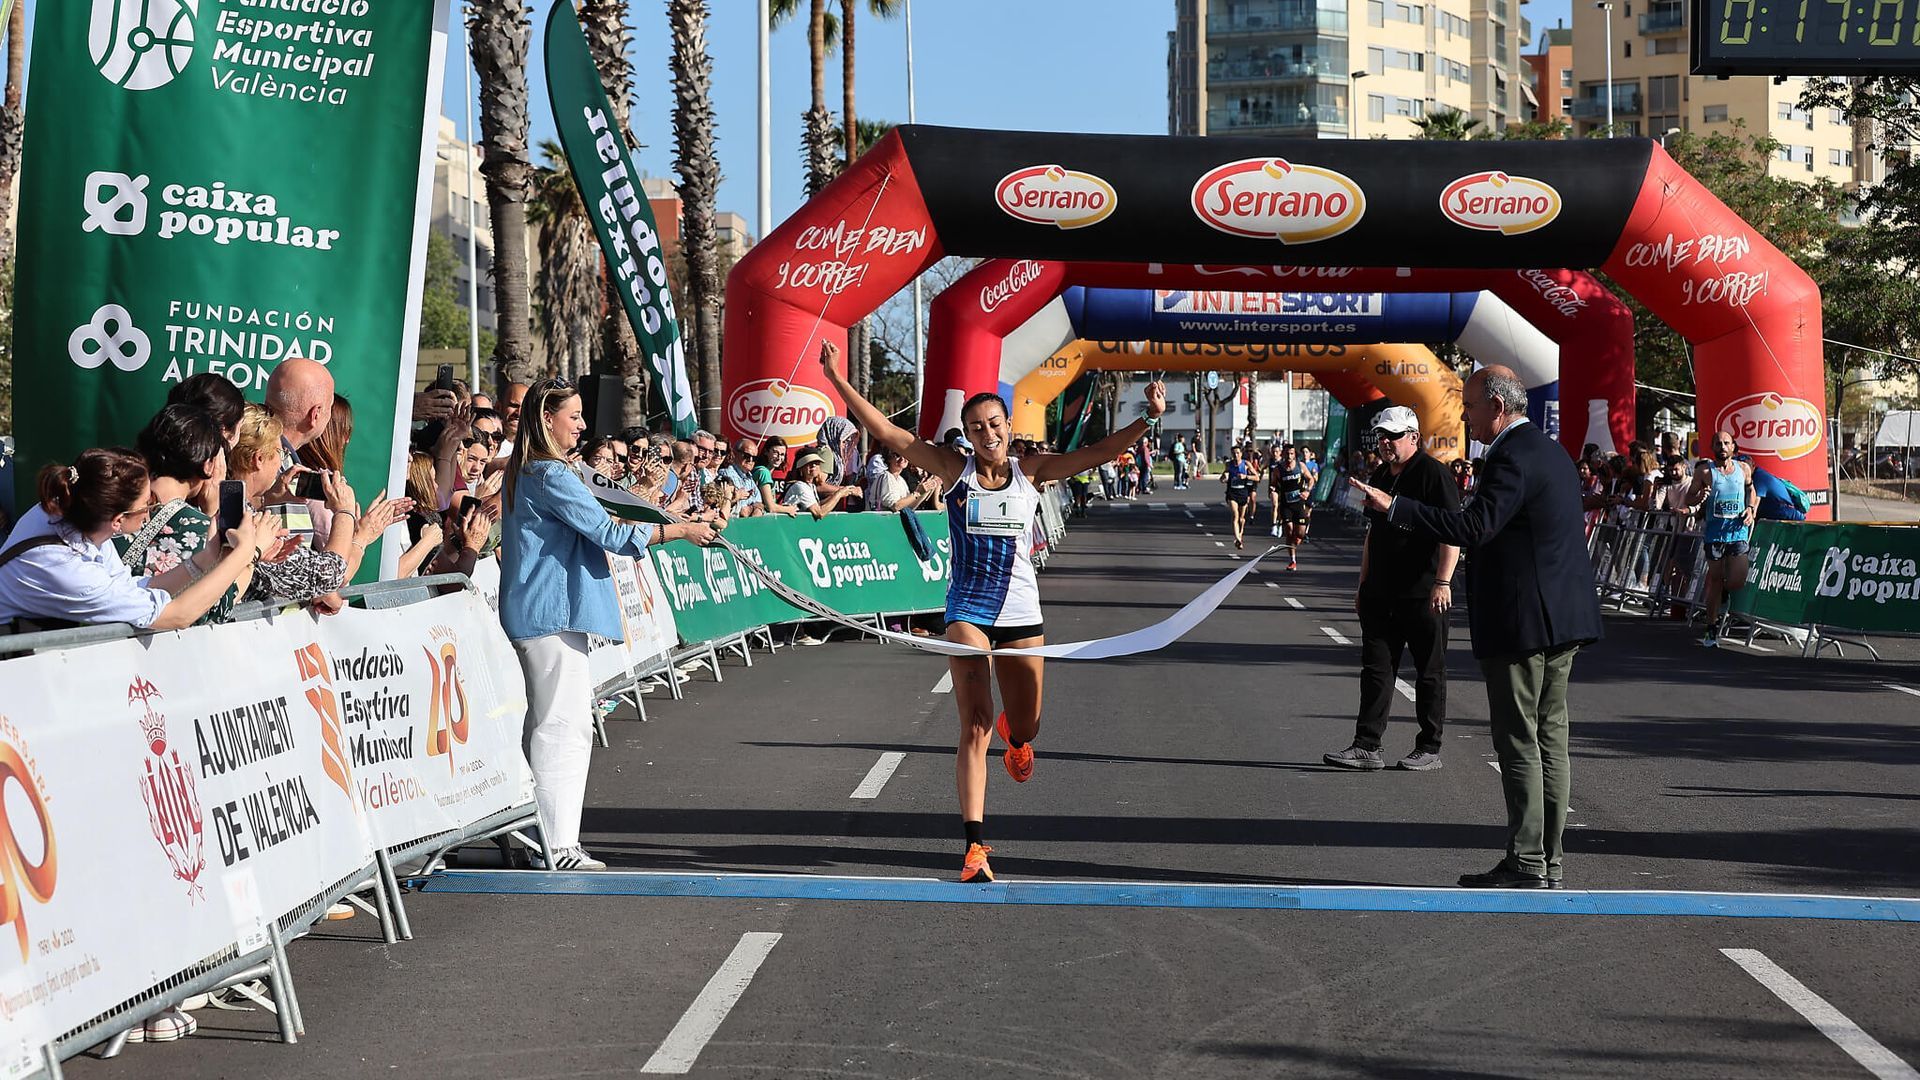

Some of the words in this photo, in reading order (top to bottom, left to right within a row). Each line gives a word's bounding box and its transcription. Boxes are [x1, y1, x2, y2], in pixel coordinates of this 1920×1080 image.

[215, 10, 373, 47] Esportiva
[1720, 0, 1920, 46] 0:17:0
[212, 39, 375, 81] Municipal
[211, 66, 347, 105] València
[162, 181, 277, 216] caixa
[1009, 181, 1105, 209] Serrano
[1211, 180, 1347, 217] Serrano
[1453, 188, 1549, 215] Serrano
[158, 211, 340, 250] popular
[795, 220, 865, 258] COME
[861, 225, 927, 256] BIEN
[600, 192, 661, 335] caixa
[1625, 233, 1694, 273] COME
[1692, 233, 1750, 266] BIEN
[169, 301, 334, 334] FUNDACIÓN
[1192, 290, 1374, 314] INTERSPORT
[1179, 320, 1357, 334] www.intersport.es
[165, 325, 333, 366] TRINIDAD
[161, 356, 271, 390] ALFON
[1375, 360, 1429, 376] divina
[736, 396, 827, 425] Serrano
[1729, 413, 1817, 439] Serrano
[998, 501, 1007, 516] 1
[827, 537, 871, 560] caixa
[1852, 552, 1917, 577] caixa
[832, 558, 899, 588] popular
[1768, 568, 1802, 594] popula
[1847, 577, 1920, 604] popul
[194, 696, 295, 779] AJUNTAMENT
[212, 801, 250, 867] DE
[242, 771, 321, 853] VALÈNCIA
